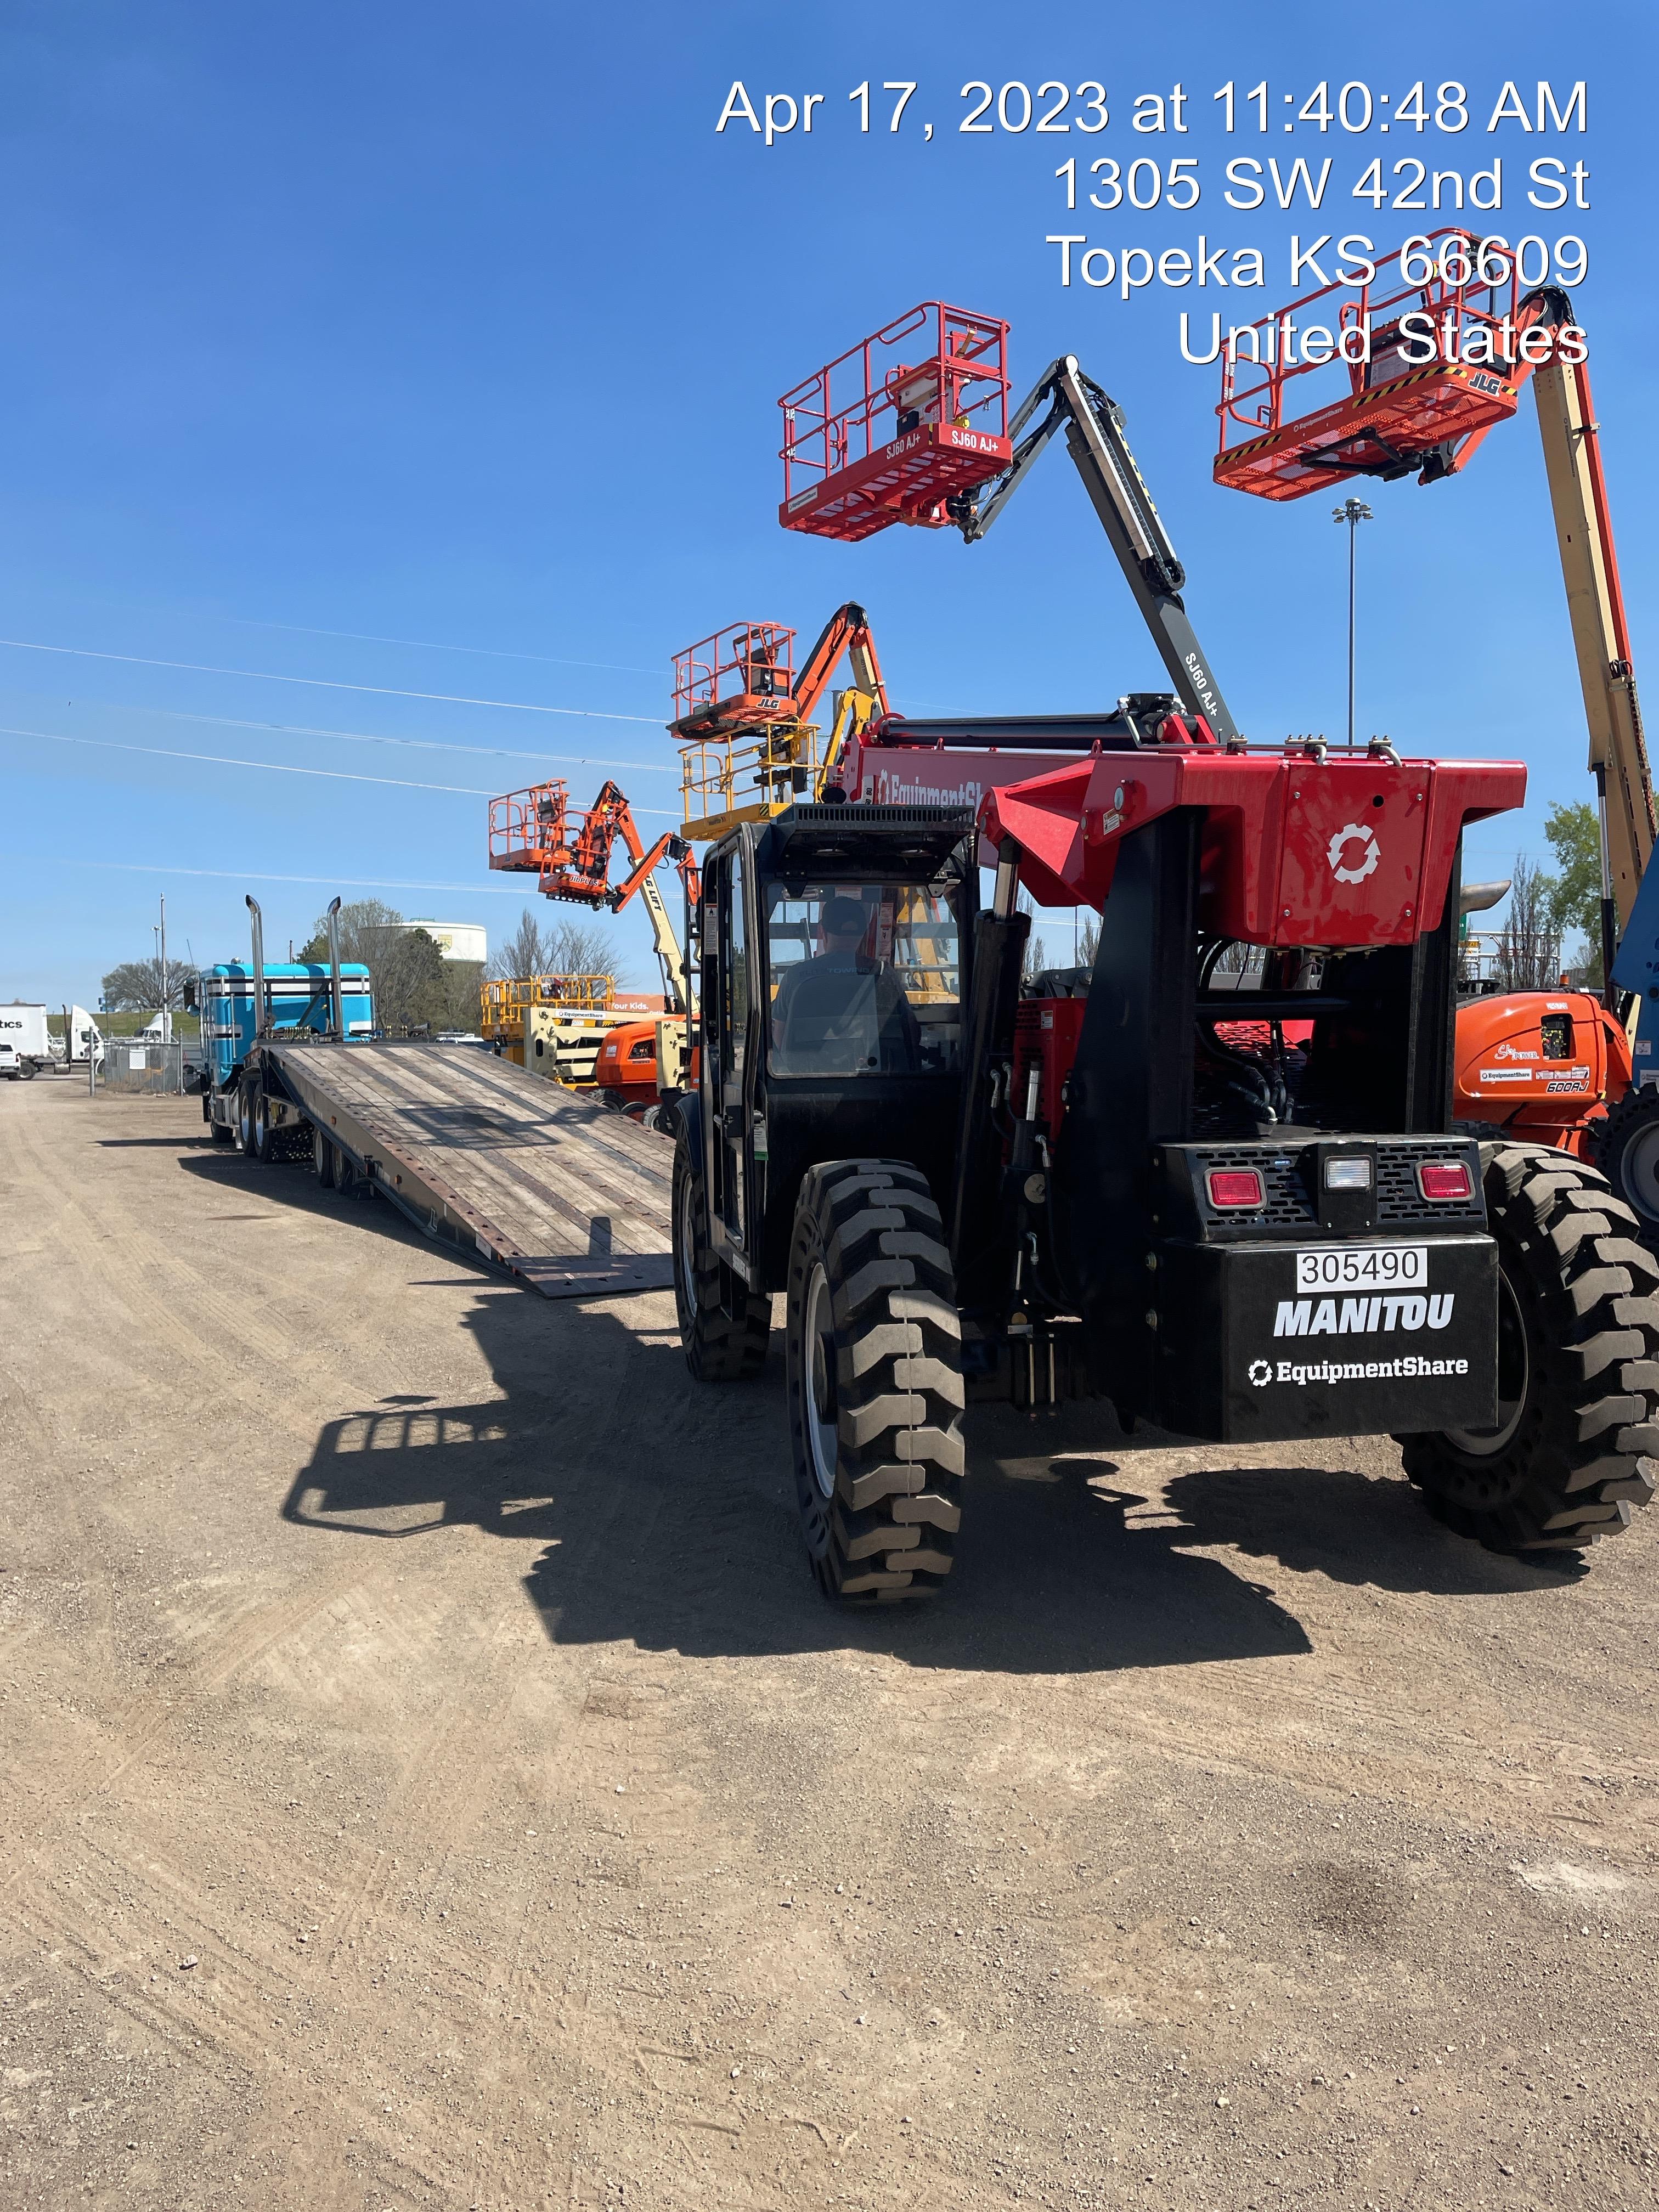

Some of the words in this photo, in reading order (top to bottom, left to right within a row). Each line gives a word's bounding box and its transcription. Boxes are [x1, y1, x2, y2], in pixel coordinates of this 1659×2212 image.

[1468, 373, 1501, 396] JLG
[886, 441, 905, 460] SJ60
[906, 433, 921, 450] AJ+
[951, 430, 977, 449] SJ60
[979, 437, 999, 453] AJ+
[1185, 652, 1207, 690] SJ60
[1201, 691, 1217, 716] AJ+
[757, 698, 780, 709] JLG
[648, 890, 662, 911] LIFT
[1547, 1081, 1589, 1093] 600AJ
[1302, 1250, 1419, 1284] 305490
[1273, 1293, 1455, 1338] MANITOU
[1276, 1357, 1469, 1385] EquipmentShare
